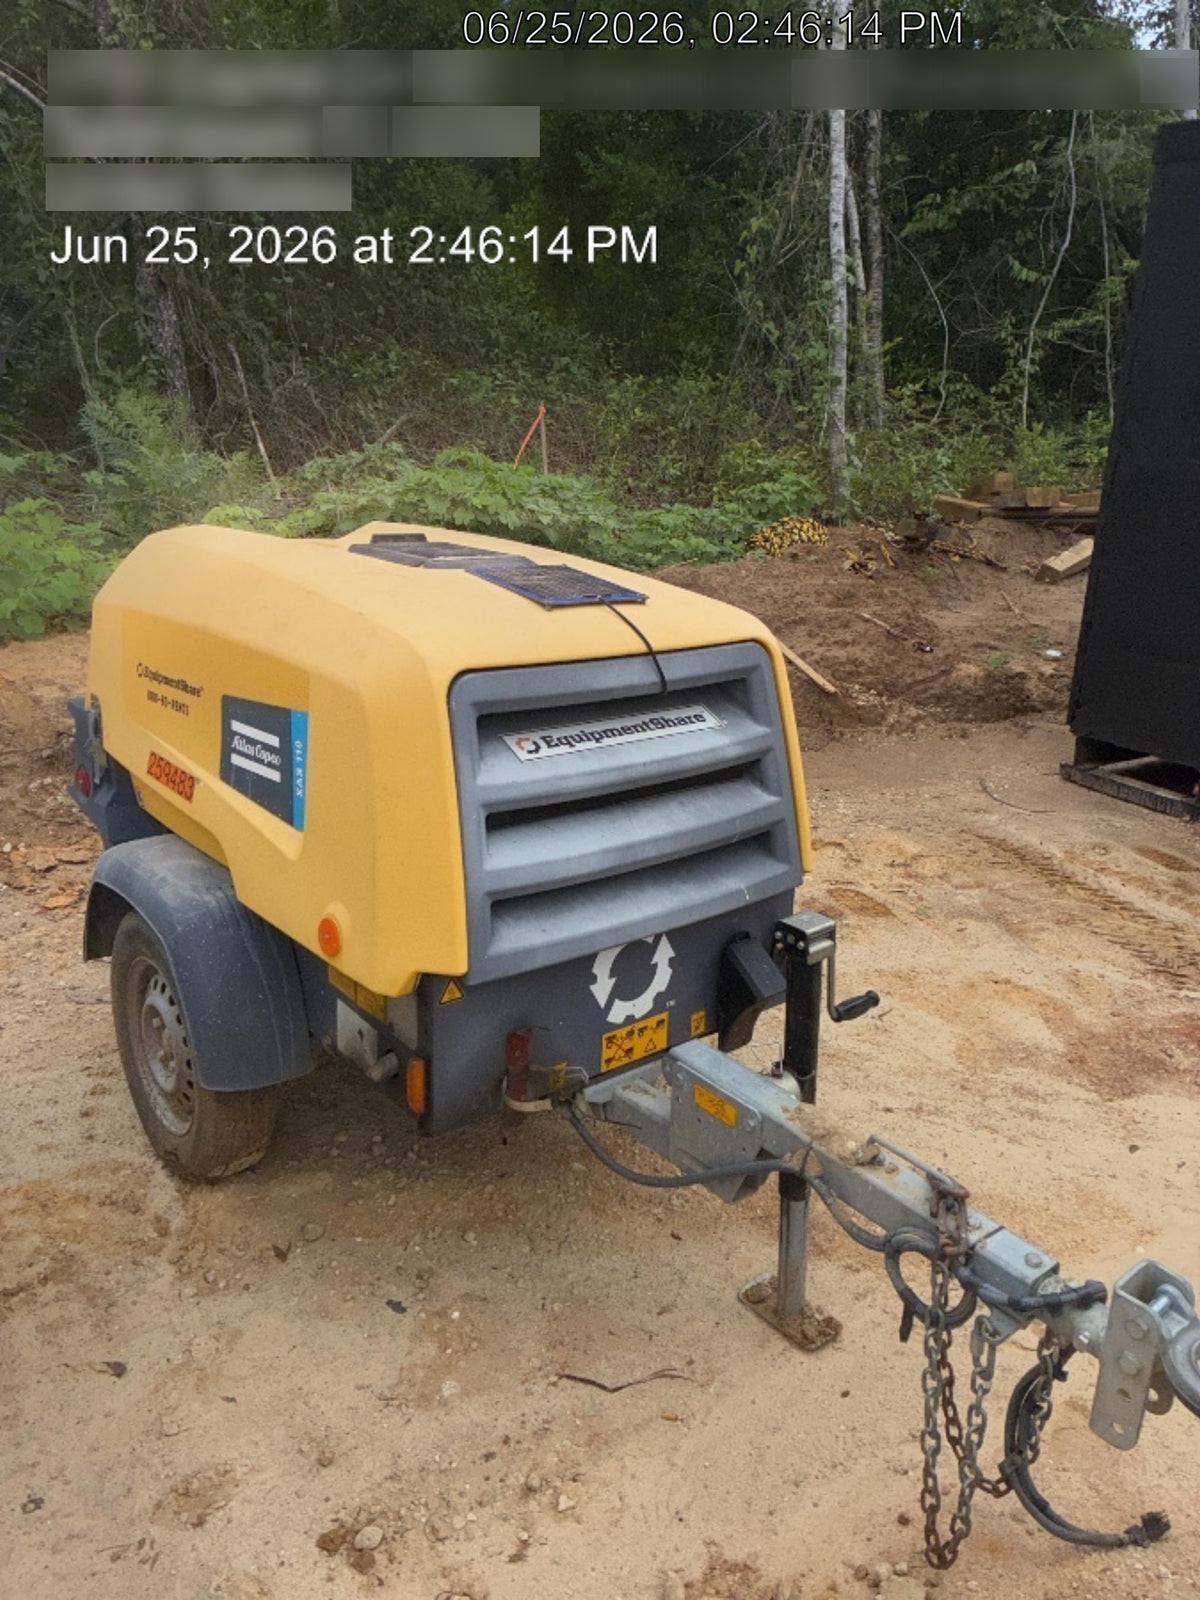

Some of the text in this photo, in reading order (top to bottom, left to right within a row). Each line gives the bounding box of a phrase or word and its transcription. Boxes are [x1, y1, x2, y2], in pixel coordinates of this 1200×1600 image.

[541, 712, 707, 748] EquipmentShare
[231, 735, 281, 766] Atlas Copco
[147, 751, 195, 804] 259483
